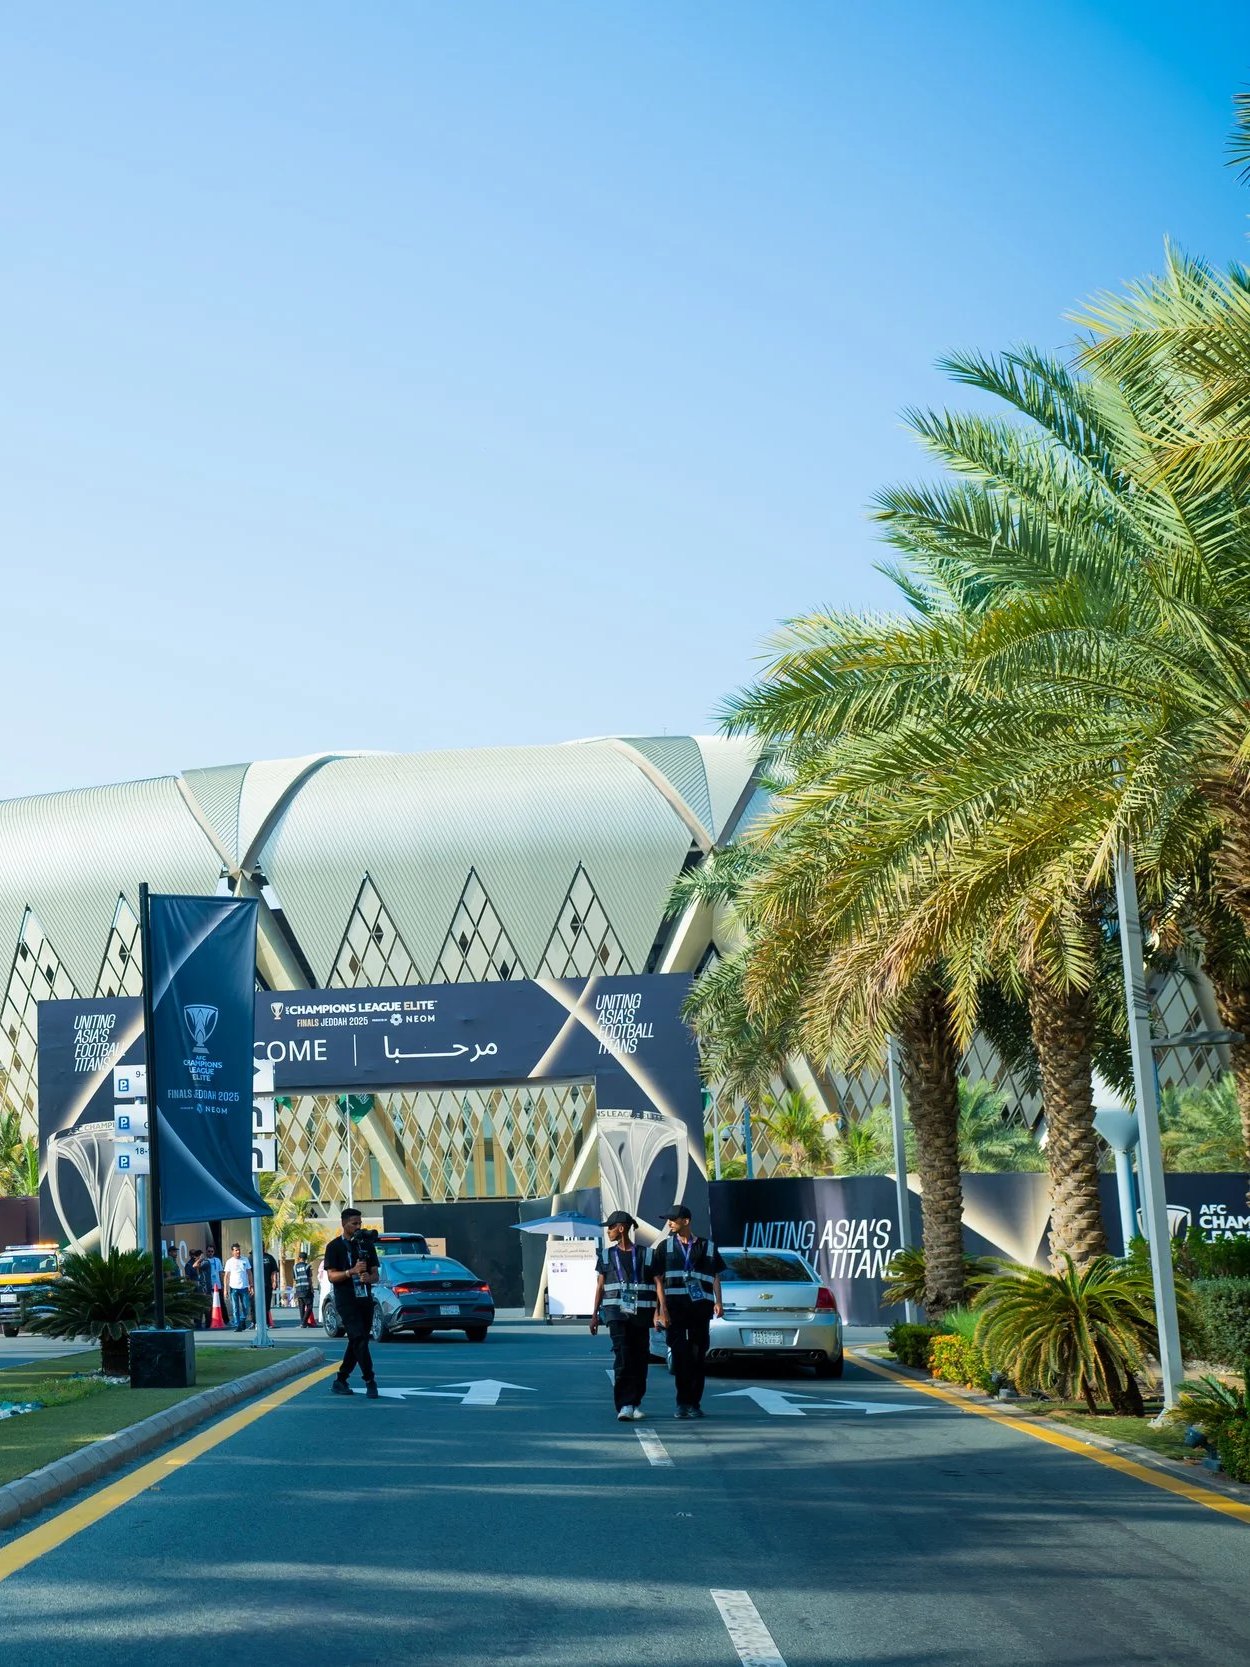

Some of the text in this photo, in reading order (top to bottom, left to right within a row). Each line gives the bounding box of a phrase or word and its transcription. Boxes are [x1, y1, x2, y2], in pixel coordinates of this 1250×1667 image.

[290, 1003, 356, 1015] CHAMPIONS
[358, 1002, 401, 1013] LEAGUE
[403, 1001, 435, 1011] ELITE
[595, 993, 642, 1010] UNITING
[74, 1014, 116, 1030] UNITING
[296, 1016, 369, 1028] FINALS JEDDAH 2025
[406, 1014, 436, 1023] NEOM
[596, 1008, 635, 1025] ASIA'S
[74, 1028, 110, 1044] ASIA'S
[598, 1022, 655, 1040] FOOTBALL
[74, 1042, 126, 1058] FOOTBALL
[253, 1039, 328, 1063] COME
[598, 1037, 638, 1054] TITANS
[74, 1057, 111, 1072] TITANS
[183, 1060, 223, 1069] CHAMPIONS
[189, 1066, 215, 1075] LEAGUE
[192, 1073, 211, 1082] ELITE
[167, 1089, 240, 1102] FINALS JEDDAH 2025
[205, 1105, 228, 1115] NEOM
[84, 1122, 115, 1131] CHAMPI
[135, 1147, 149, 1155] 18-
[1199, 1204, 1227, 1215] AFC
[743, 1218, 892, 1249] UNITING ASIA'S
